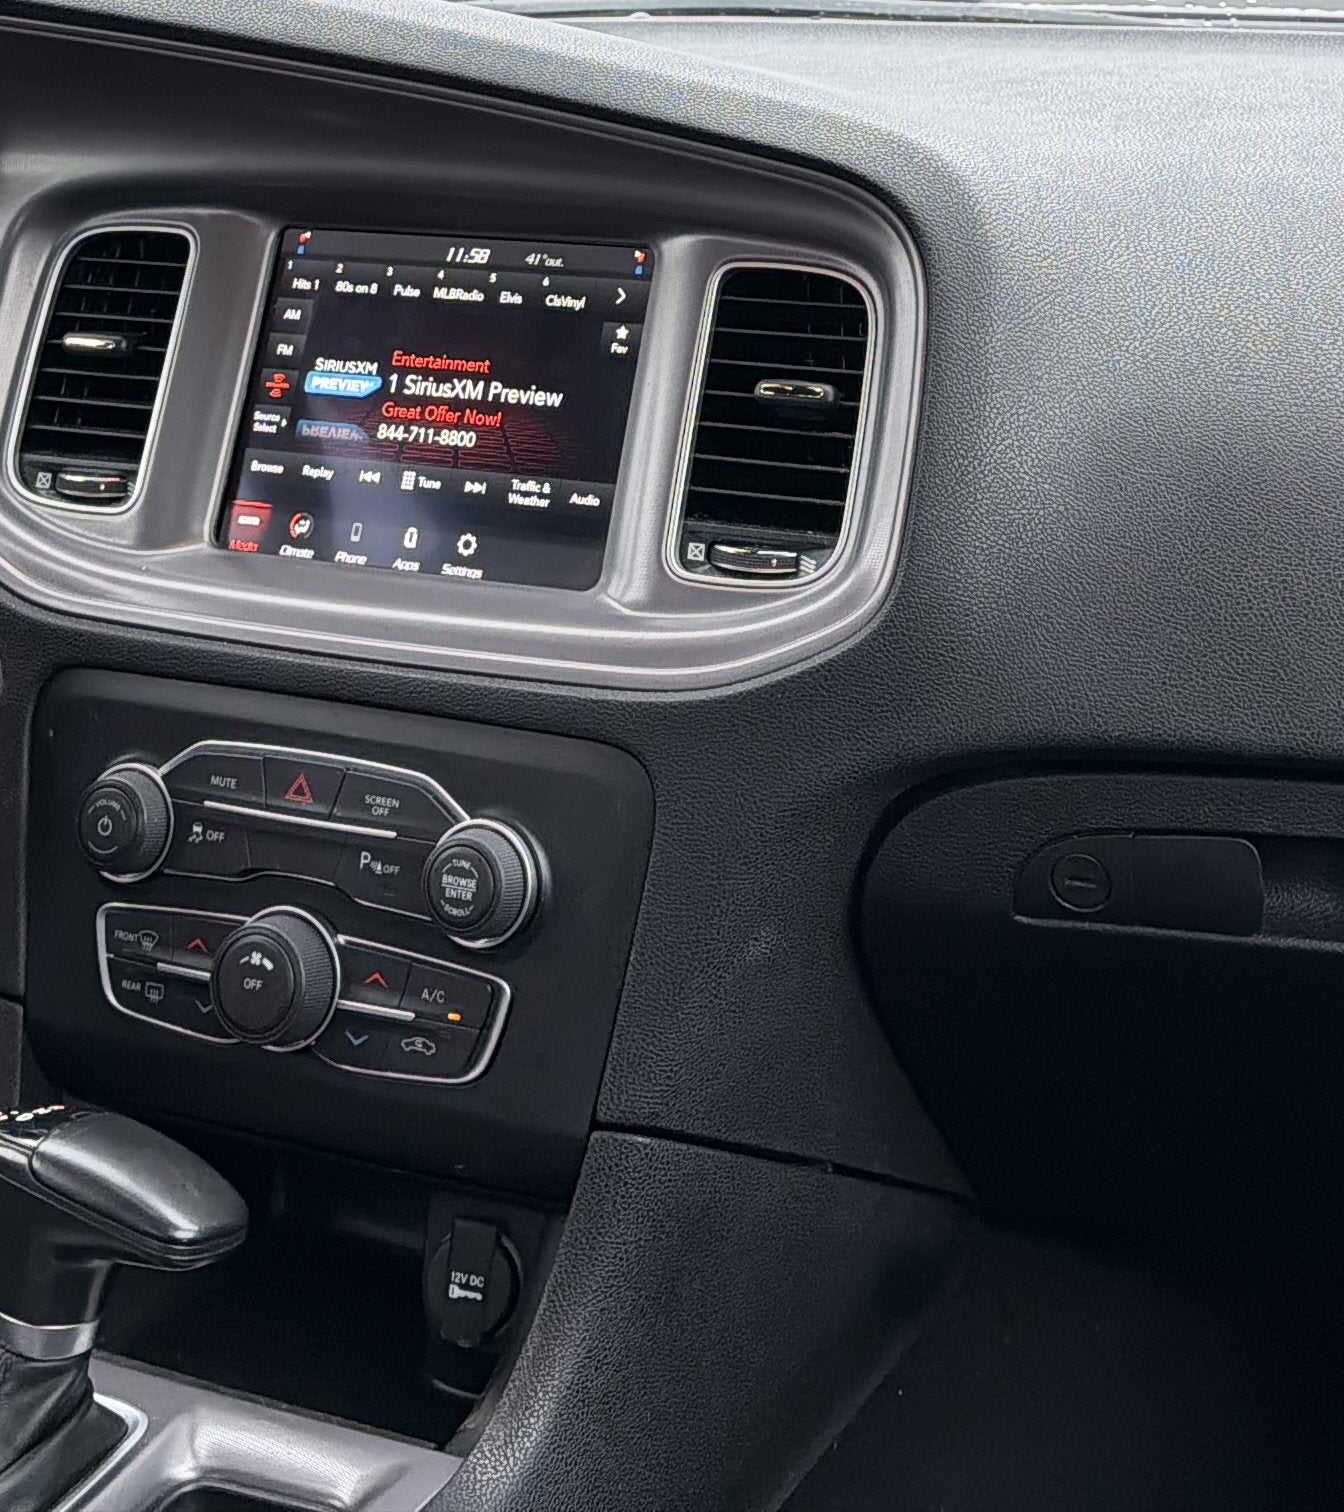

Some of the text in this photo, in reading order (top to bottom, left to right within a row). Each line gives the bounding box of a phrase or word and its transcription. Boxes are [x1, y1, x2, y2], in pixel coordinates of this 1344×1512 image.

[446, 247, 491, 264] 11:58
[287, 260, 550, 287] 1 2 3 4 5 6
[292, 277, 321, 291] Hits 1
[335, 280, 378, 295] 80s on 8
[393, 284, 421, 298] Pulse
[433, 287, 485, 303] MLBRadio
[499, 290, 523, 305] Elvis
[545, 294, 586, 311] ClsVinyl
[283, 308, 301, 321] AM
[276, 343, 294, 356] FM
[610, 343, 629, 355] Fav
[314, 357, 378, 376] SIRIUSXM
[391, 350, 491, 374] Entertainment
[310, 375, 376, 393] PREVIEW
[389, 373, 564, 407] 1 SiriusXM Preview
[253, 410, 281, 423] Source
[381, 401, 503, 428] Great Offer Now!
[252, 421, 277, 434] Select
[376, 423, 477, 448] 844-711-8800
[250, 459, 285, 474] Browse
[302, 464, 335, 481] Replay
[418, 476, 442, 490] Tune
[511, 478, 552, 494] Traffic &
[507, 492, 551, 508] Weather
[569, 492, 601, 507] Audio
[334, 550, 368, 566] Phone
[391, 557, 421, 573] Apps
[440, 563, 484, 580] Settings
[210, 775, 237, 789] MUTE
[95, 798, 121, 812] VOLUME
[364, 794, 400, 809] SCREEN
[371, 804, 390, 817] OFF
[206, 829, 225, 843] OFF
[382, 865, 400, 875] OFF
[452, 859, 472, 870] TUNE
[442, 874, 477, 888] BROWSE
[445, 888, 473, 902] ENTER
[444, 905, 470, 918] SCROLL
[114, 929, 139, 943] FRONT
[122, 979, 142, 991] REAR
[243, 978, 263, 991] OFF
[421, 988, 445, 1004] A/C
[451, 1270, 485, 1288] 12V DC
